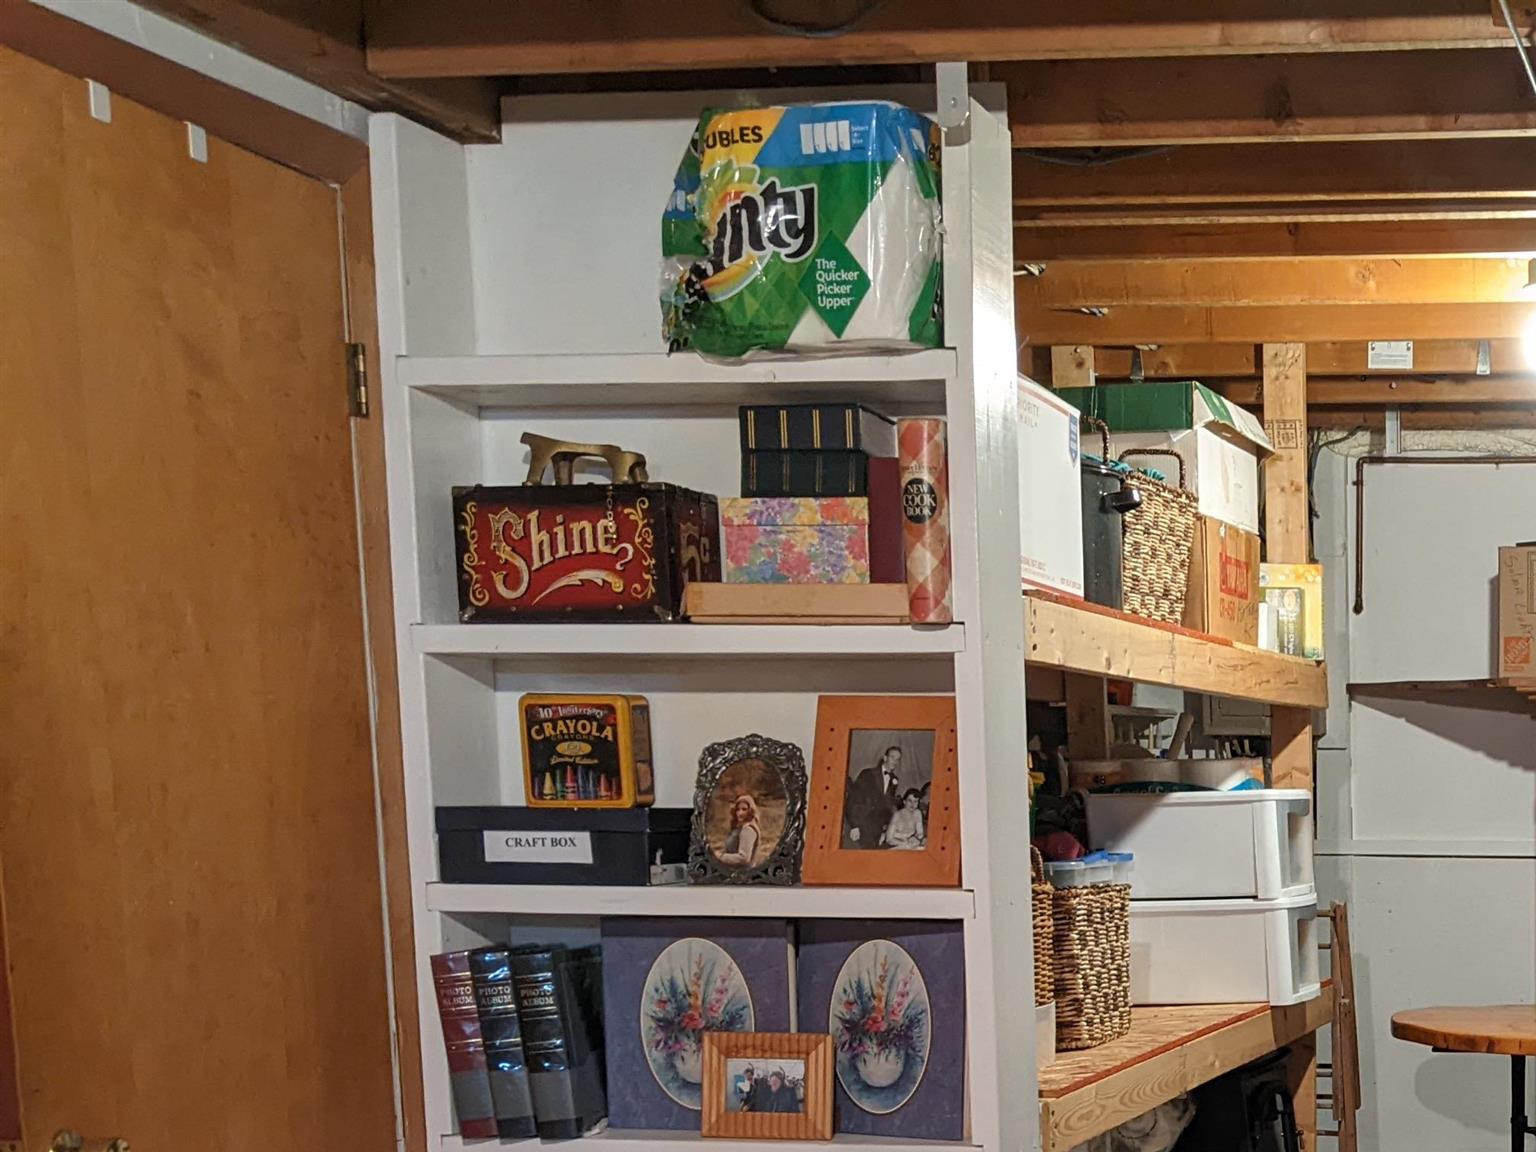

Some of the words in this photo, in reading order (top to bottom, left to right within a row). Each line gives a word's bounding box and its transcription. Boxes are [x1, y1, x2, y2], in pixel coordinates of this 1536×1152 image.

[815, 258, 837, 270] The
[815, 269, 860, 283] Quicker
[816, 283, 853, 295] Picker
[817, 296, 855, 310] Upper
[907, 484, 929, 494] NEW
[903, 494, 937, 507] COOK
[906, 506, 933, 516] BOOK
[487, 506, 635, 600] Shine
[530, 719, 614, 741] CRAYOLA
[504, 836, 547, 849] CRAFT
[550, 836, 577, 848] BOX
[479, 985, 511, 996] PHOTO
[480, 995, 512, 1006] ALBUM
[522, 997, 554, 1008] ALBUM
